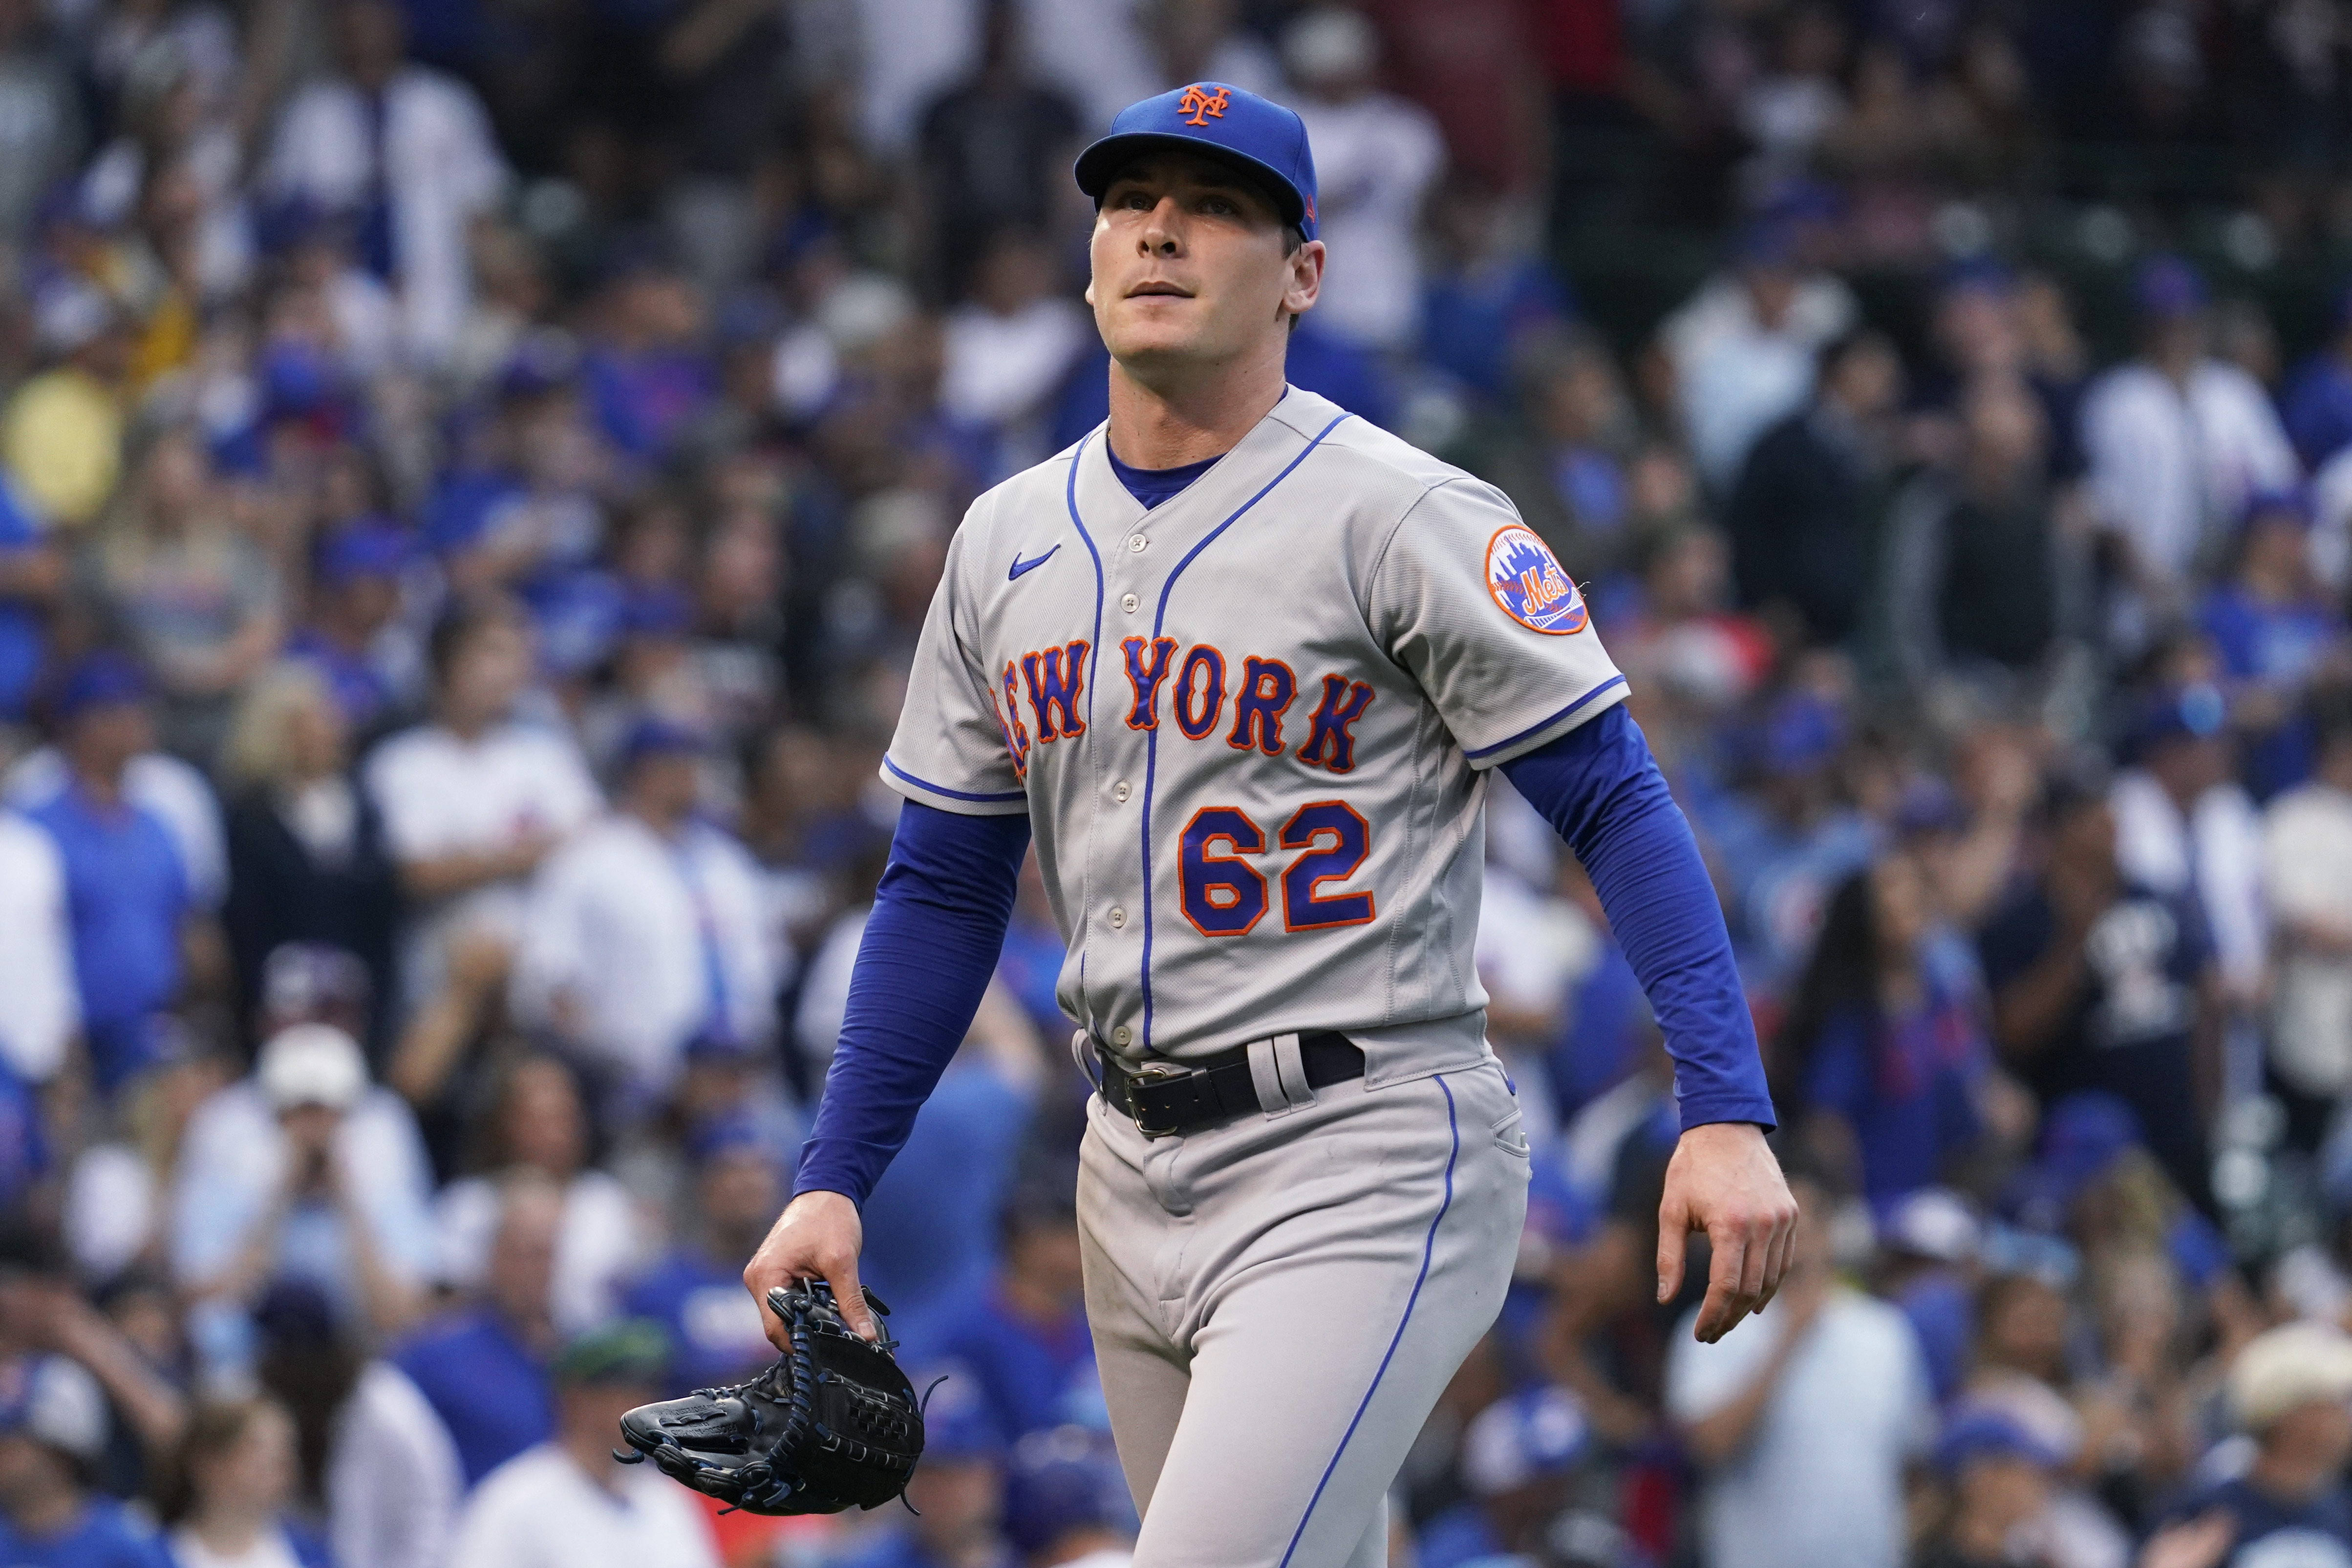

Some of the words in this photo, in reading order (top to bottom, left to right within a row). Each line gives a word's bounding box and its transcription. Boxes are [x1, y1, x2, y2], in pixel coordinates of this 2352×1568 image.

[1520, 562, 1569, 615] Mets
[1119, 635, 1374, 774] YORK
[1177, 799, 1376, 937] 62
